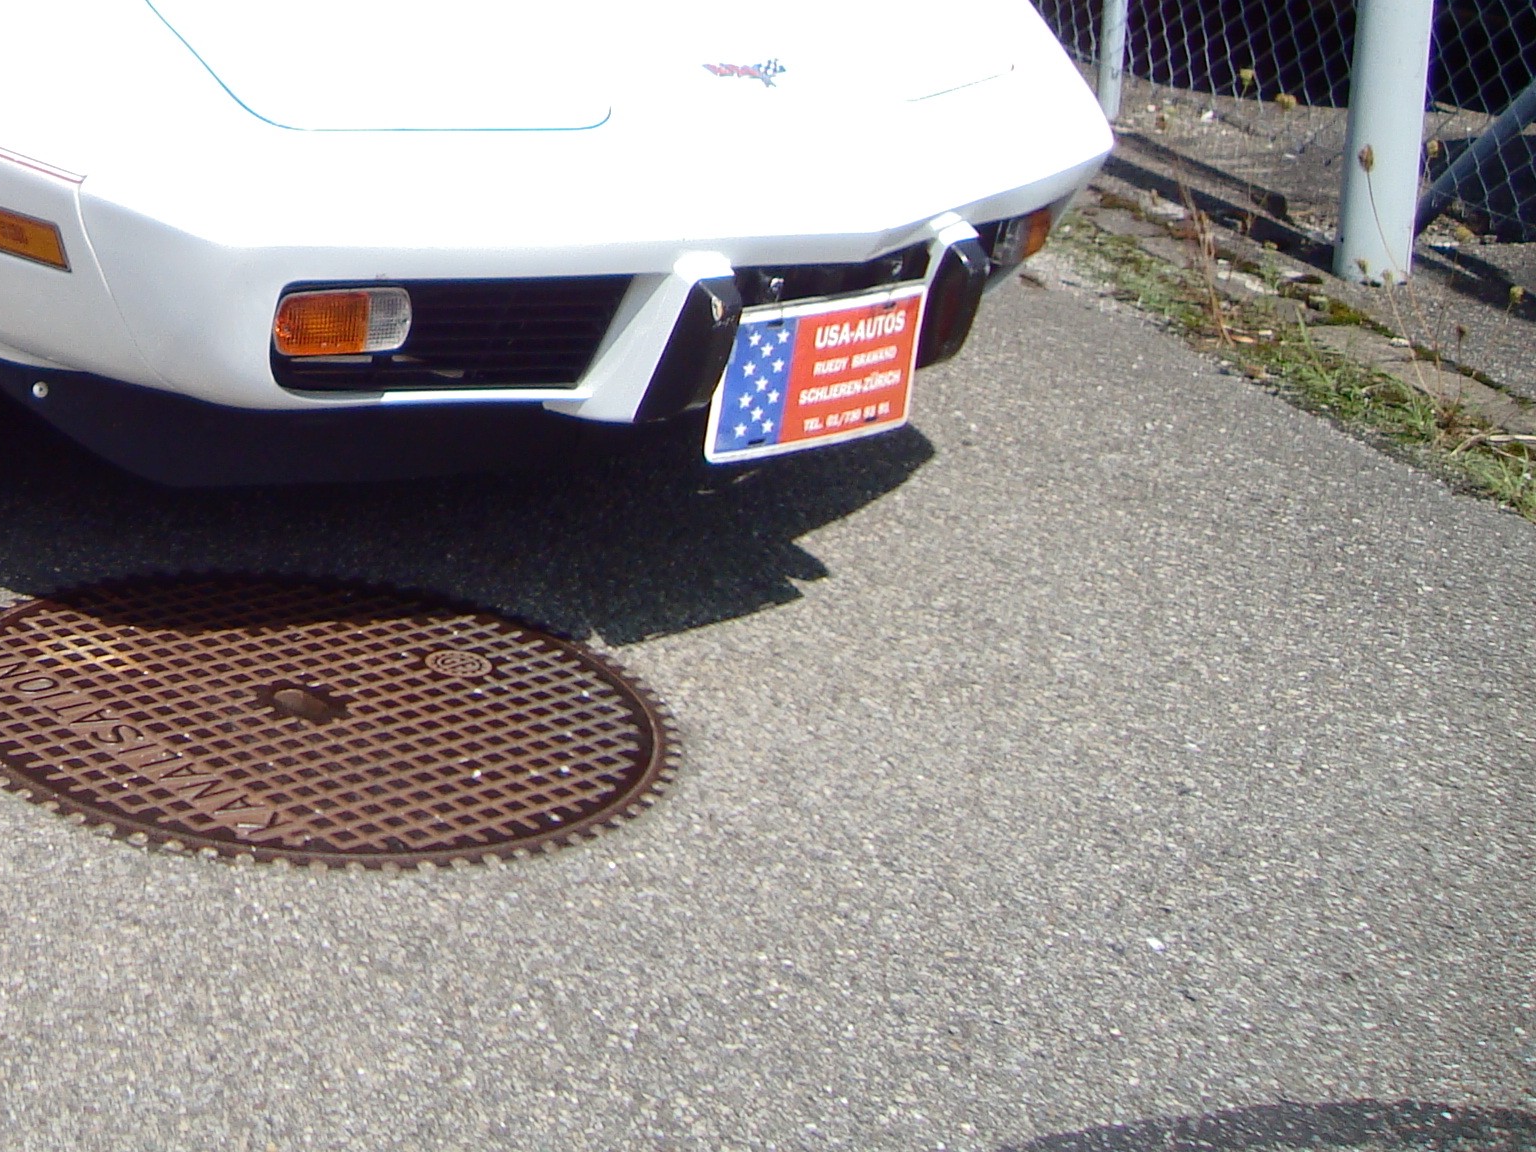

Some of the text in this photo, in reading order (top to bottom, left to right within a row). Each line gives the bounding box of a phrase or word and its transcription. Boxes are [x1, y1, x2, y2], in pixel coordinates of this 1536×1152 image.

[814, 310, 906, 349] USA-AUTOS
[813, 357, 849, 376] RUEDY
[798, 369, 902, 405] SCHLIEREN-ZÜRICH
